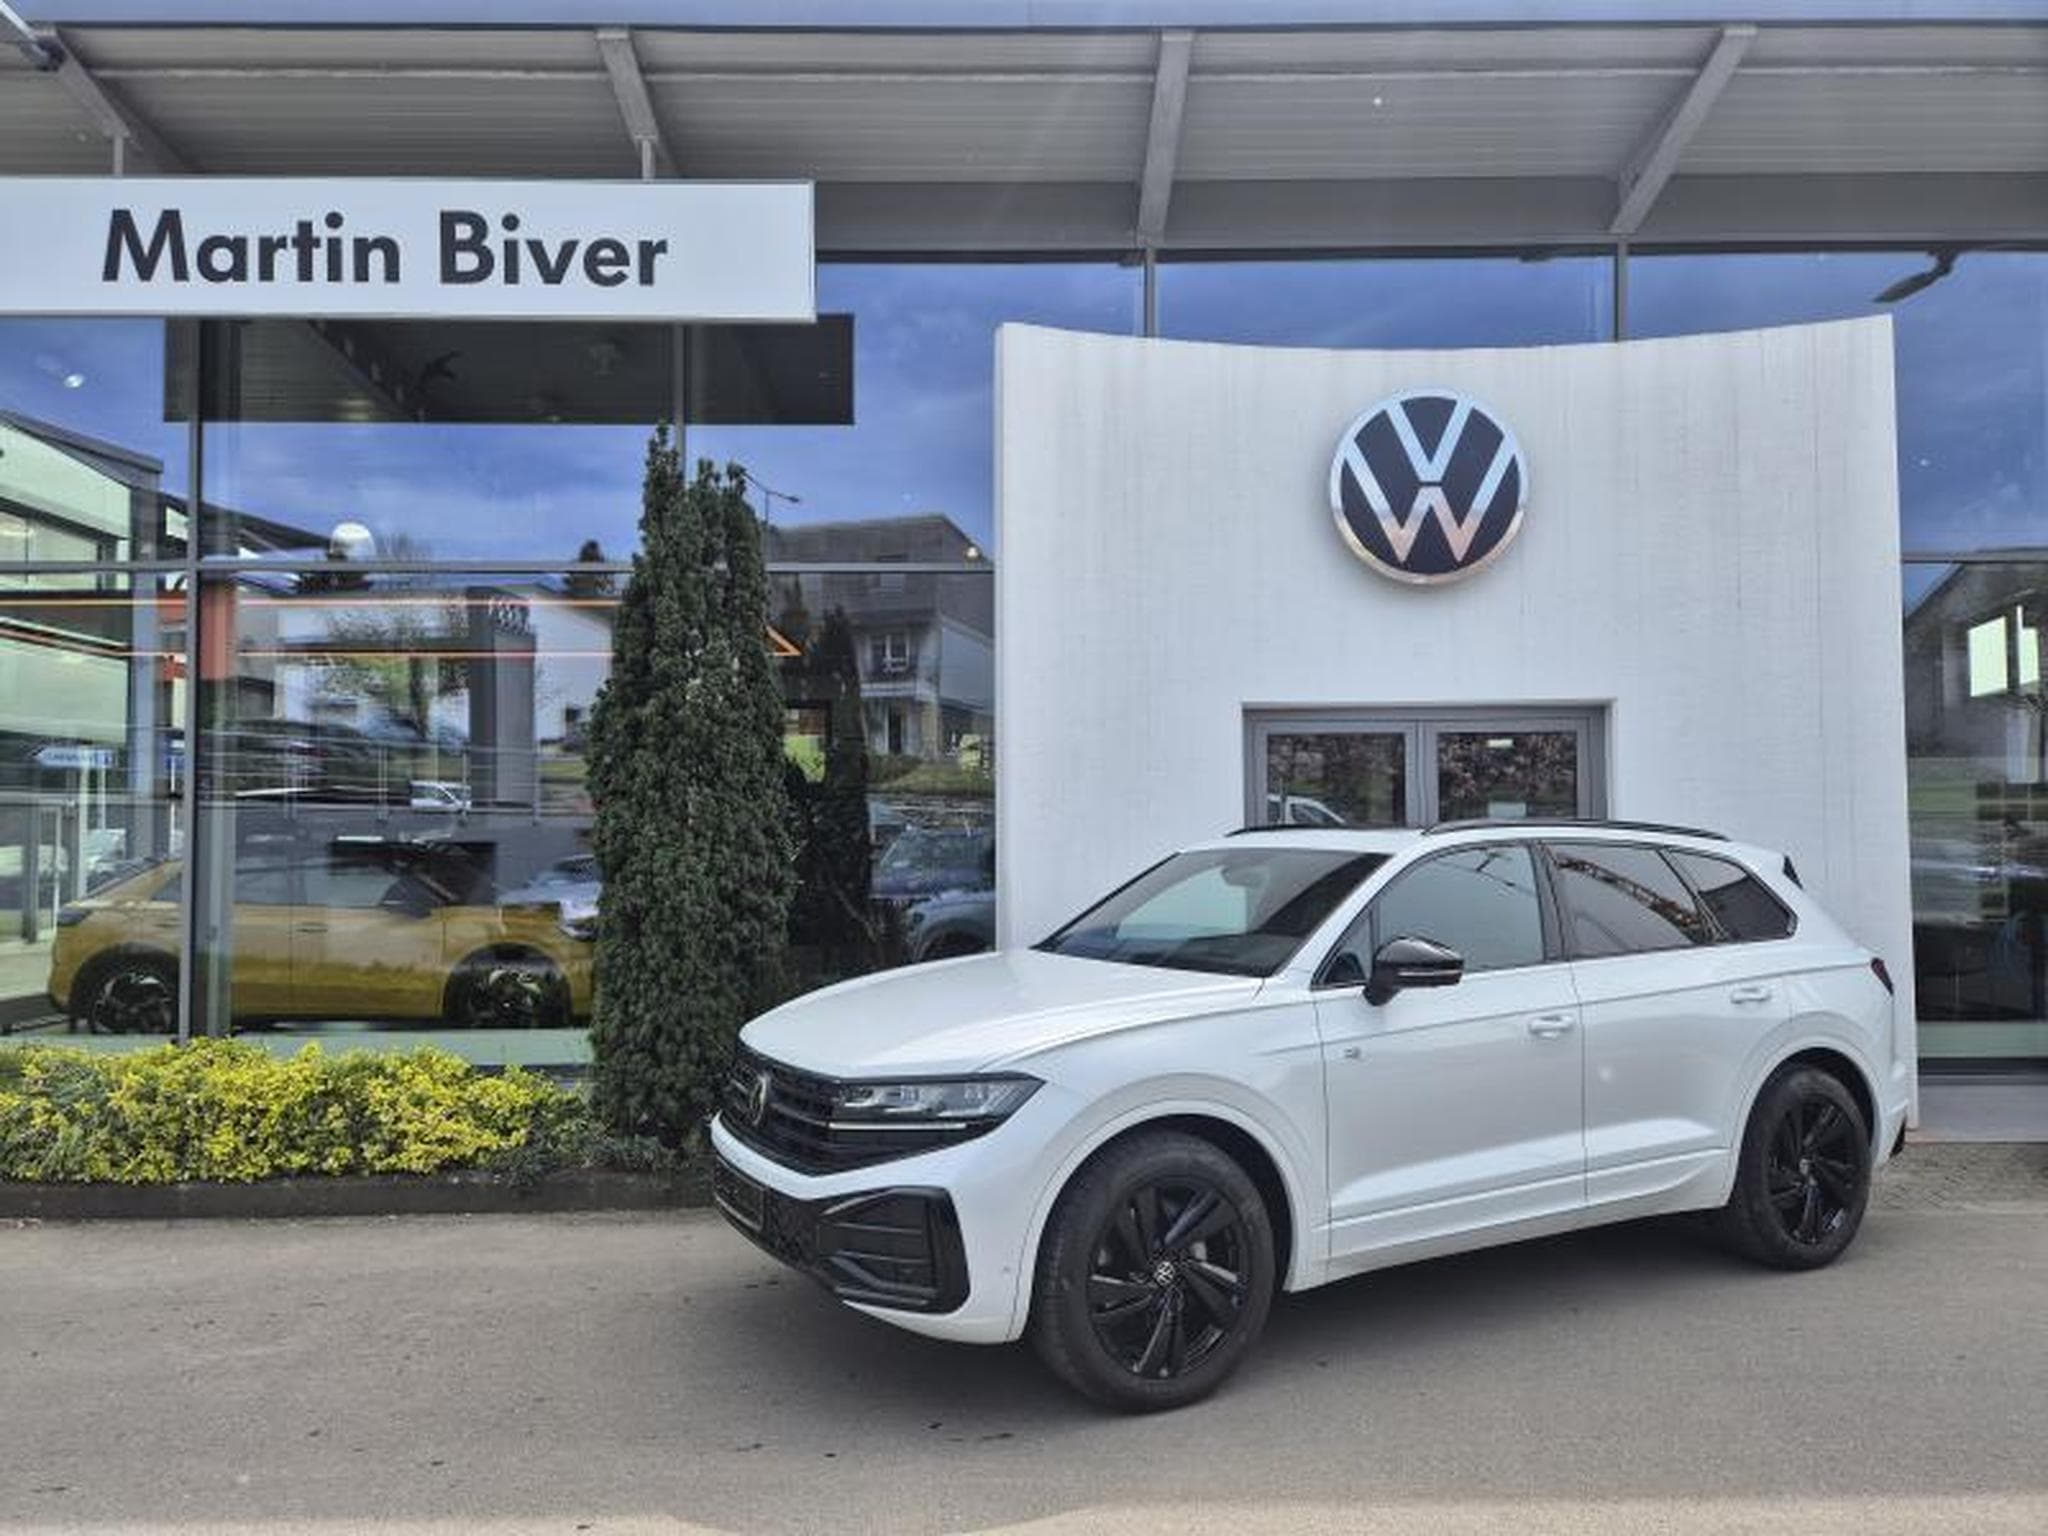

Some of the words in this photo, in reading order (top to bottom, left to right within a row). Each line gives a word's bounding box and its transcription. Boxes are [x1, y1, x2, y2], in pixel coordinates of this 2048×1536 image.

[102, 209, 400, 283] Martin
[439, 210, 668, 286] Biver
[1338, 392, 1520, 568] VW
